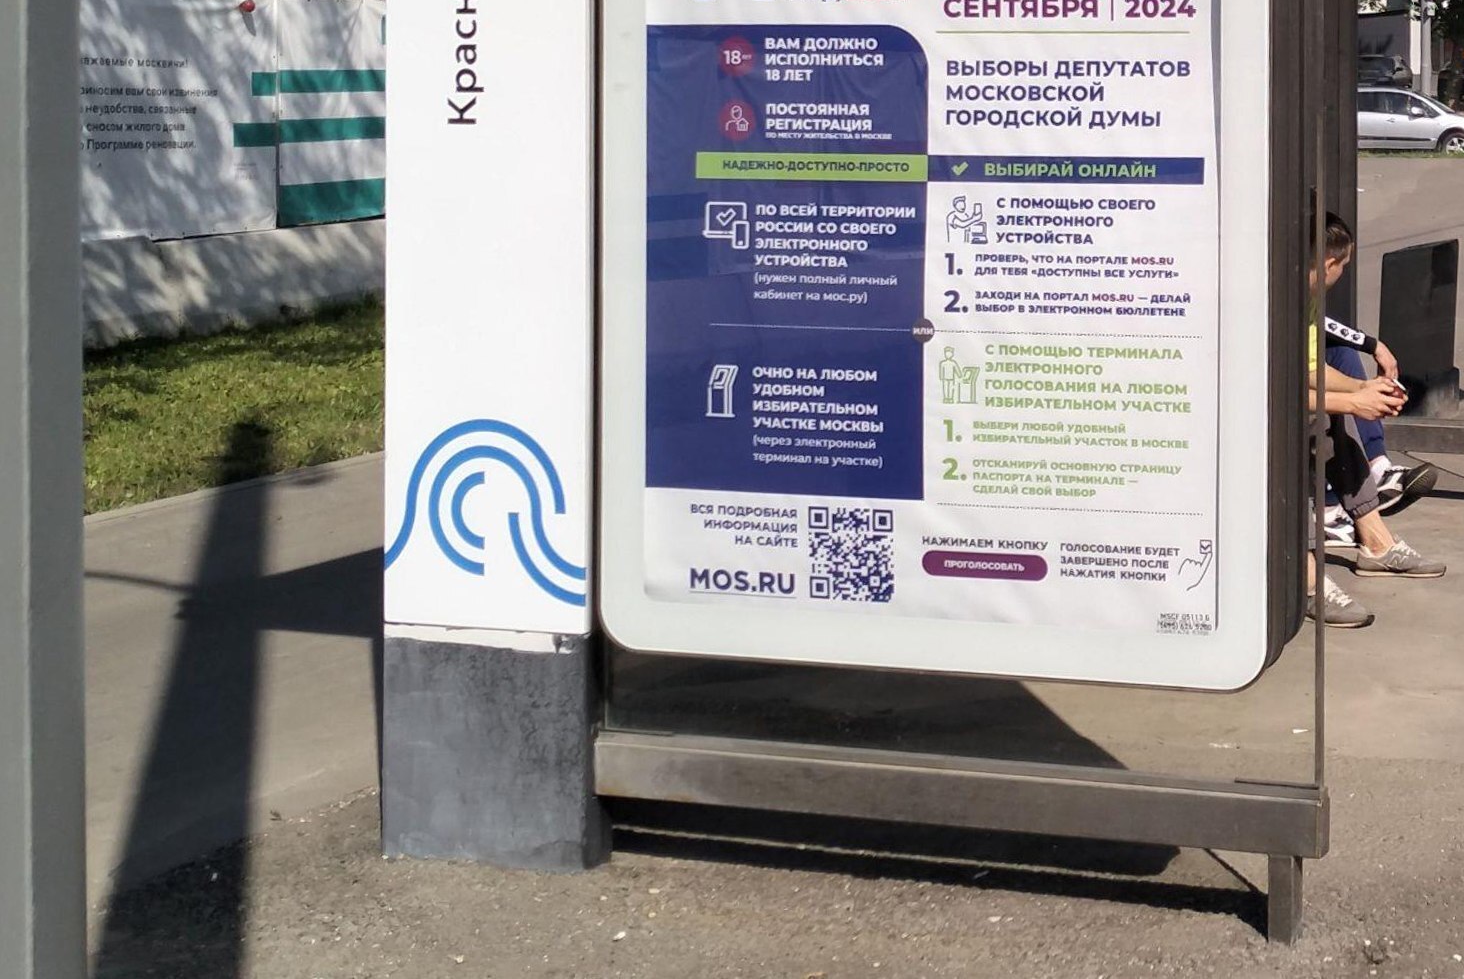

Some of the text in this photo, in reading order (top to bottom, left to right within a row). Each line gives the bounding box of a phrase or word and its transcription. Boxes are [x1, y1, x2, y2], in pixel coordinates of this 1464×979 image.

[765, 37, 878, 52] ВАМ ДОЛЖНО
[723, 50, 741, 65] 18
[765, 53, 884, 66] ИСПОЛНИТЬСЯ
[766, 69, 813, 82] 18 ЛЕТ
[946, 60, 1191, 80] ВЫБОРЫ ДЕПУТАТОВ
[946, 81, 1105, 102] МОСКОВСКОЙ
[766, 103, 870, 116] ПОСТОЯННАЯ
[766, 118, 872, 132] РЕГИСТРАЦИЯ
[945, 107, 1161, 130] ГОРОДСКОЙ ДУМЫ
[984, 160, 1157, 178] ВЫБИРАЙ ОНЛАЙН
[756, 202, 916, 218] ПО ВСЕЙ ТЕРРИТОРИИ
[996, 198, 1156, 211] С ПОМОЩЬЮ СВОЕГО
[756, 221, 896, 235] РОССИИ СО СВОЕГО
[996, 215, 1114, 228] ЭЛЕКТРОННОГО
[755, 238, 868, 251] ЭЛЕКТРОННОГО
[996, 230, 1094, 245] УСТРОЙСТВА
[755, 252, 848, 268] УСТРОЙСТВА
[945, 252, 963, 276] 1.
[975, 253, 1174, 266] ПРОВЕРЬ, ЧТО НА ПОРТАЛЕ MOS.RU
[754, 271, 898, 286] (нужен полный личный
[974, 266, 1179, 279] ДЛЯ ТЕБЯ «ДОСТУПНЫ ВСЕ УСЛУГИ»
[754, 288, 803, 301] кабинет
[806, 292, 820, 301] на
[943, 290, 969, 313] 2.
[975, 291, 1191, 304] ЗАХОДИ НА ПОРТАЛ MOS.RU ДЕЛАЙ
[975, 304, 1187, 317] ВЫБОР В ЭЛЕКТРОННОМ БЮЛЛЕТЕНЕ
[985, 344, 1183, 360] С ПОМОЩЬЮ ТЕРМИНАЛА
[752, 367, 877, 382] ОЧНО НА ЛЮБОМ
[985, 362, 1103, 376] ЭЛЕКТРОННОГО
[752, 383, 825, 397] УДОБНОМ
[985, 380, 1187, 395] ГОЛОСОВАНИЯ НА ЛЮБОМ
[752, 401, 878, 416] ИЗБИРАТЕЛЬНОМ
[985, 396, 1191, 413] ИЗБИРАТЕЛЬНОМ УЧАСТКЕ
[752, 417, 884, 433] УЧАСТКЕ МОСКВЫ
[973, 420, 1126, 434] ВЫБЕРИ ЛЮБОЙ УДОБНЫЙ
[753, 434, 876, 450] (через электронный
[973, 433, 1189, 449] ИЗБИРАТЕЛЬНЫЙ УЧАСТОК В МОСКВЕ
[752, 452, 883, 469] терминал на участке)
[972, 458, 1182, 475] ОТСКАНИРУЙ ОСНОВНУЮ СТРАНИЦУ
[973, 472, 1126, 486] ПАСПОРТА НА ТЕРМИНАЛЕ
[972, 483, 1096, 498] СДЕЛАЙ СВОЙ ВЫБОР
[690, 503, 797, 518] ВСЯ ПОДРОБНАЯ
[704, 519, 798, 534] ИНФОРМАЦИЯ
[735, 534, 798, 548] НА САЙТЕ
[922, 535, 1048, 551] НАЖИМАЕМ КНОПКУ
[1060, 543, 1180, 557] ГОЛОСОВАНИЕ БУДЕТ
[943, 559, 1025, 572] ПРОГОЛОСОВАТЬ
[1060, 555, 1169, 569] ЗАВЕРШЕНО ПОСЛЕ
[690, 567, 796, 595] MOS.RU
[1060, 568, 1166, 582] НАЖАТИЯ КНОПКИ
